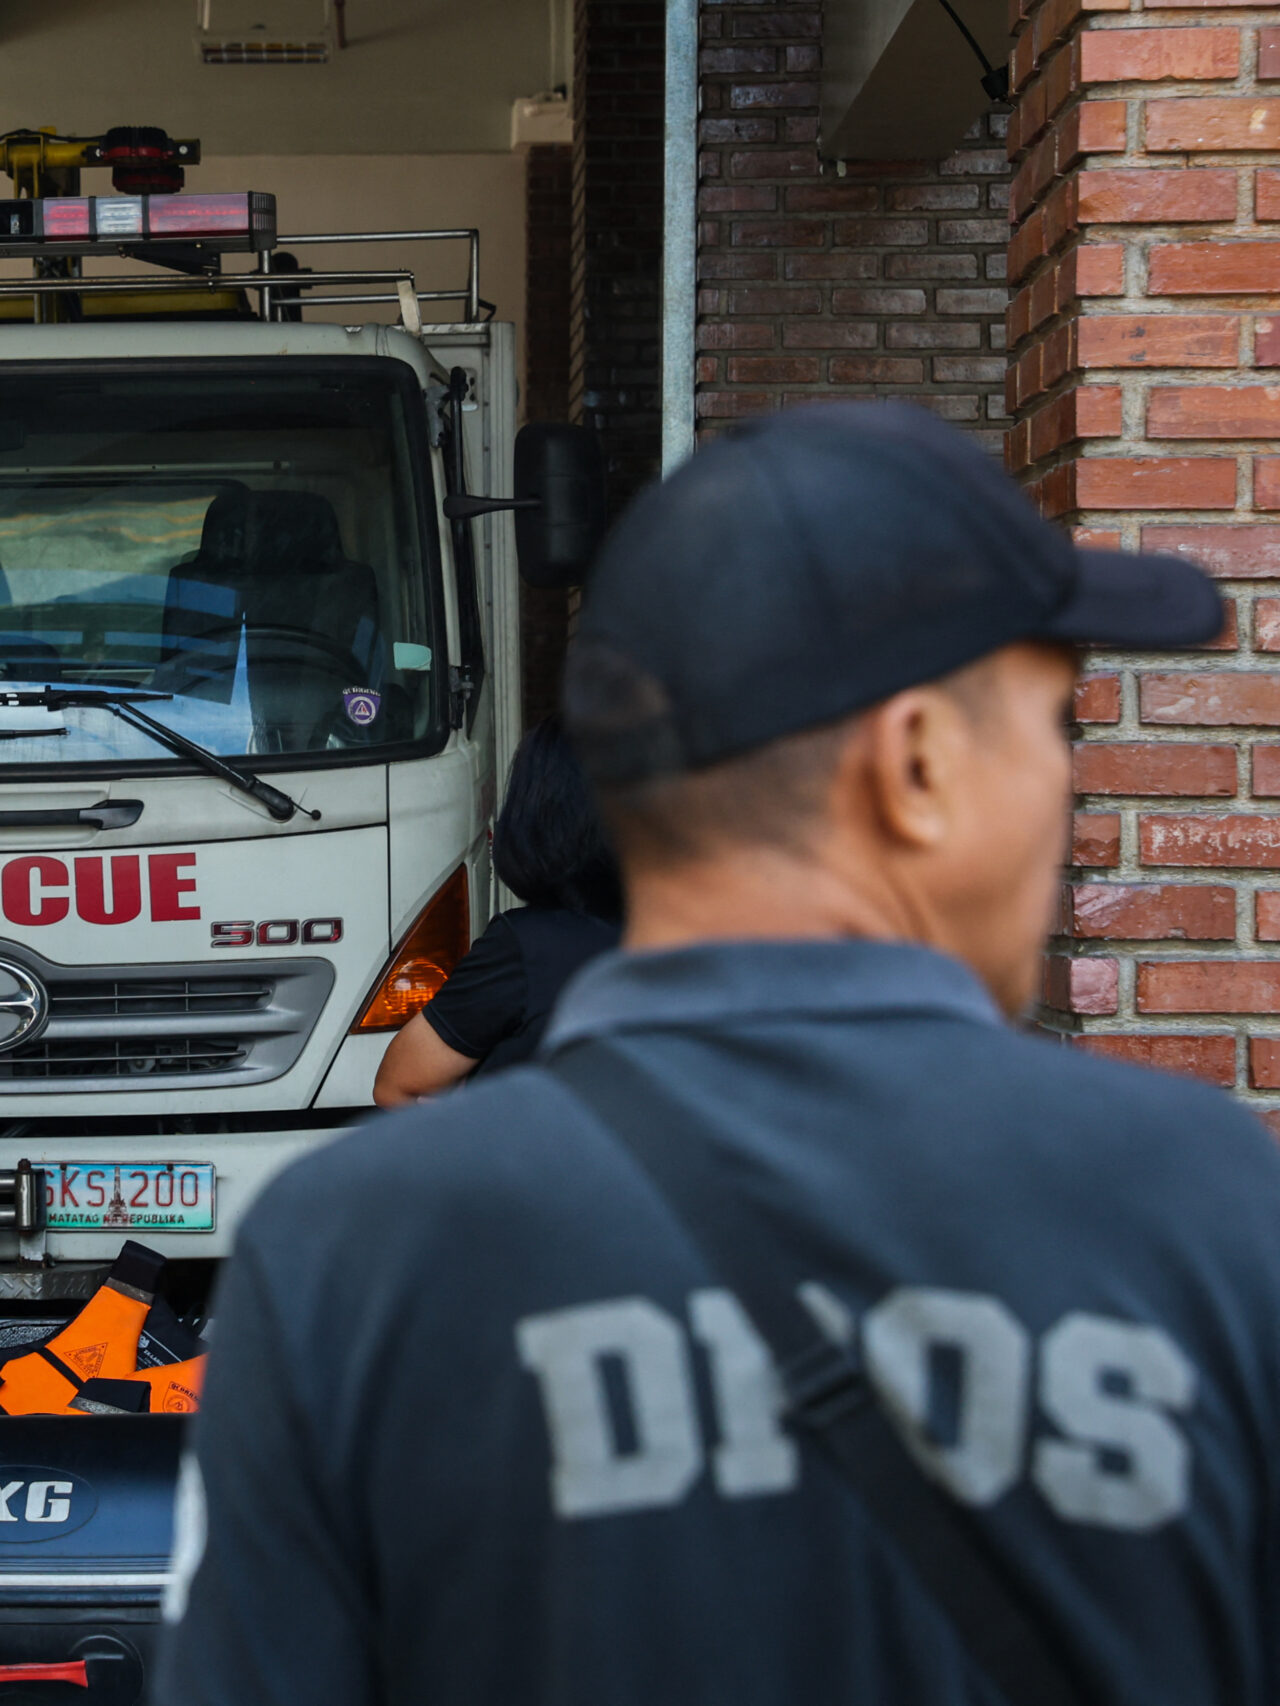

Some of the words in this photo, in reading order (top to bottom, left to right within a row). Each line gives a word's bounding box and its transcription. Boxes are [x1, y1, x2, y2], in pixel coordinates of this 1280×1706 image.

[210, 917, 344, 949] 500
[130, 1171, 199, 1208] 200
[48, 1213, 100, 1224] MATATAG
[120, 1213, 185, 1224] REPUBLIKA
